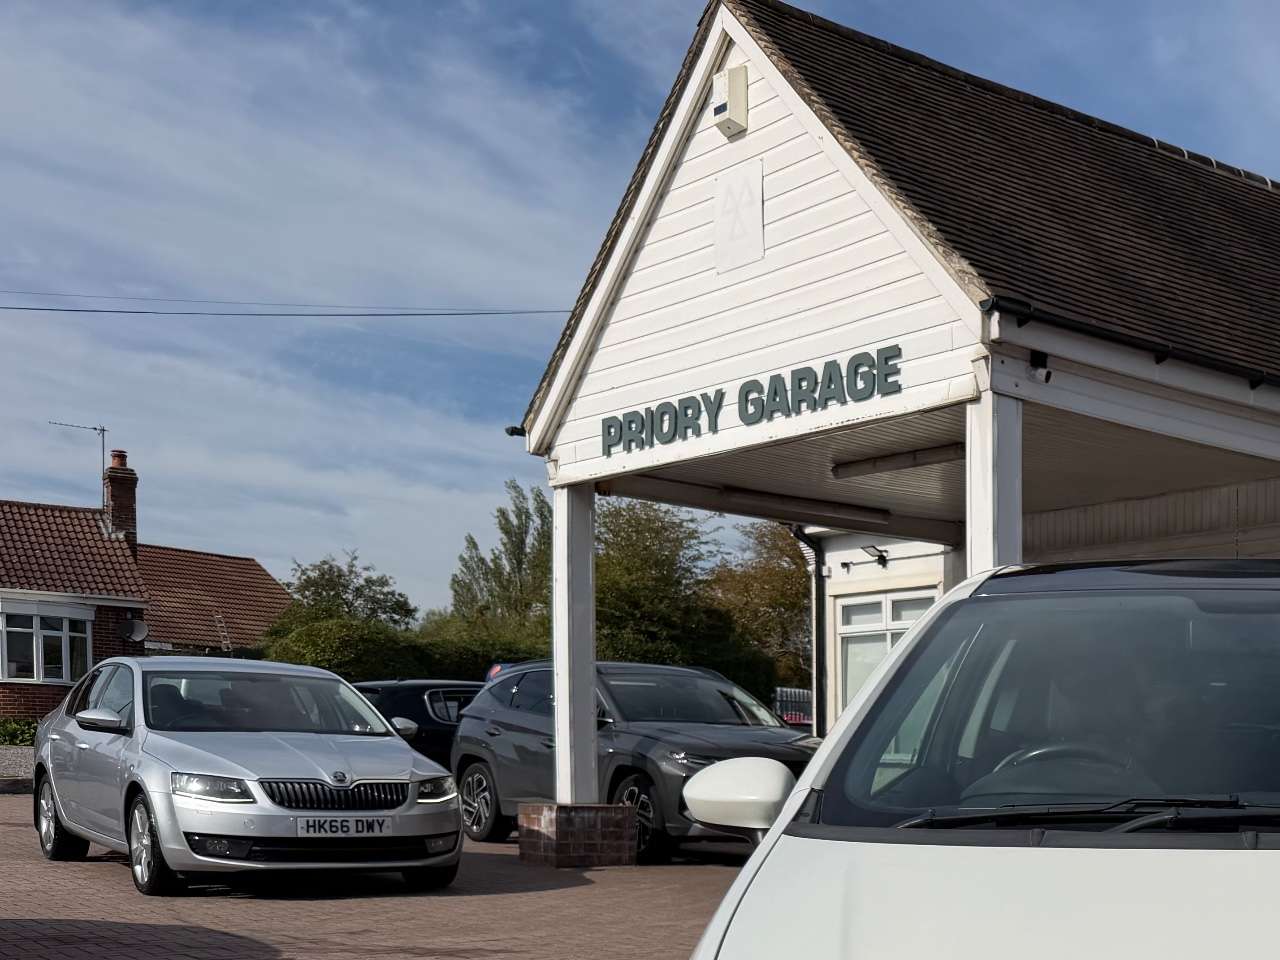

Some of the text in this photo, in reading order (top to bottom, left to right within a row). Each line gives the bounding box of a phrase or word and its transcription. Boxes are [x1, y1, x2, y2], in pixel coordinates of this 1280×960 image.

[601, 344, 902, 457] PRIORY GARAGE
[306, 819, 385, 834] HK66 DWY
